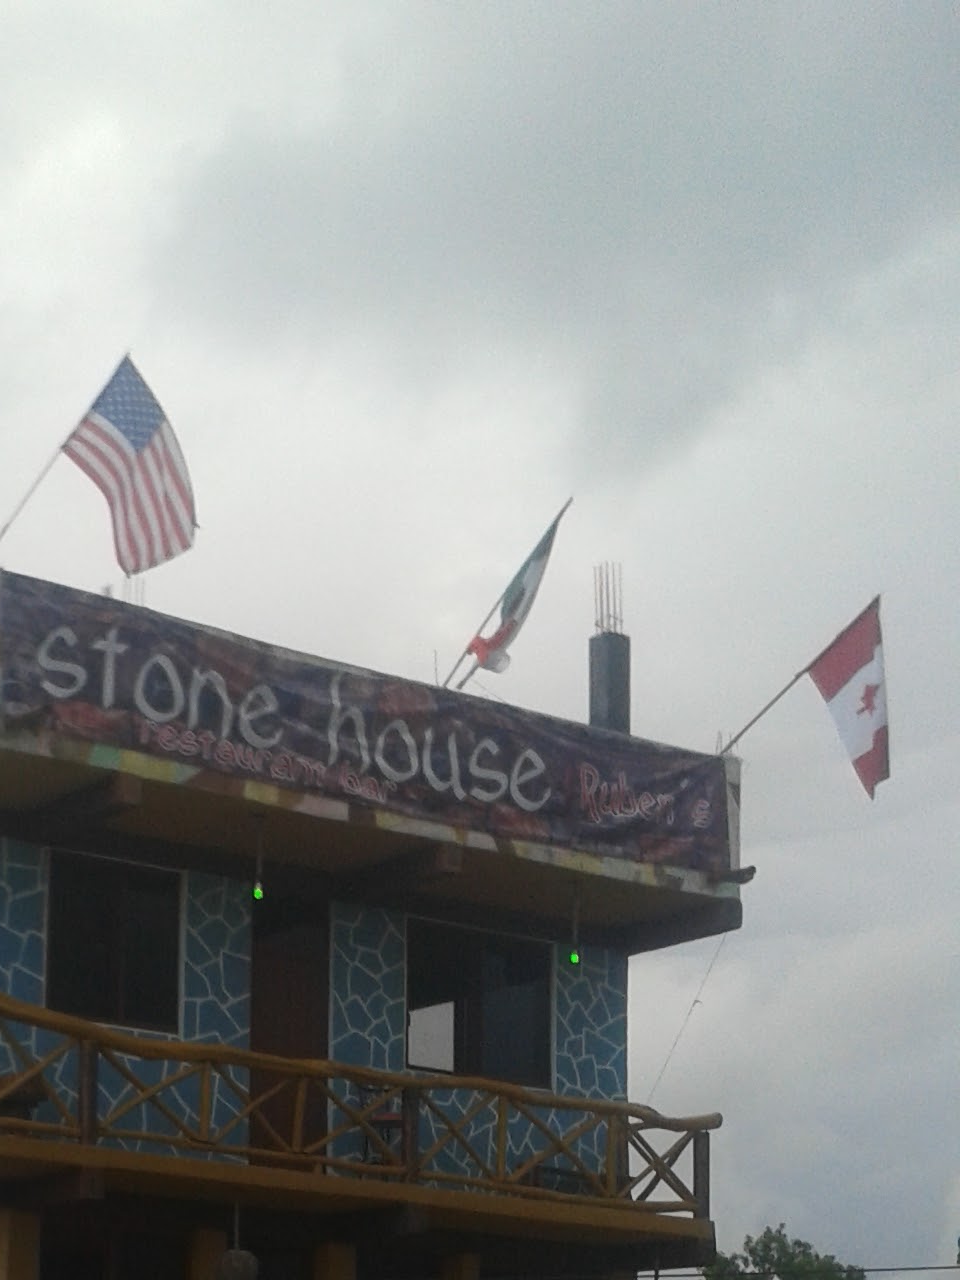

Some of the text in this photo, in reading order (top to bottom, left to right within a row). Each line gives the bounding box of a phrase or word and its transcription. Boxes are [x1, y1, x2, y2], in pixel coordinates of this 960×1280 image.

[38, 626, 552, 811] stone house
[339, 764, 398, 803] bar
